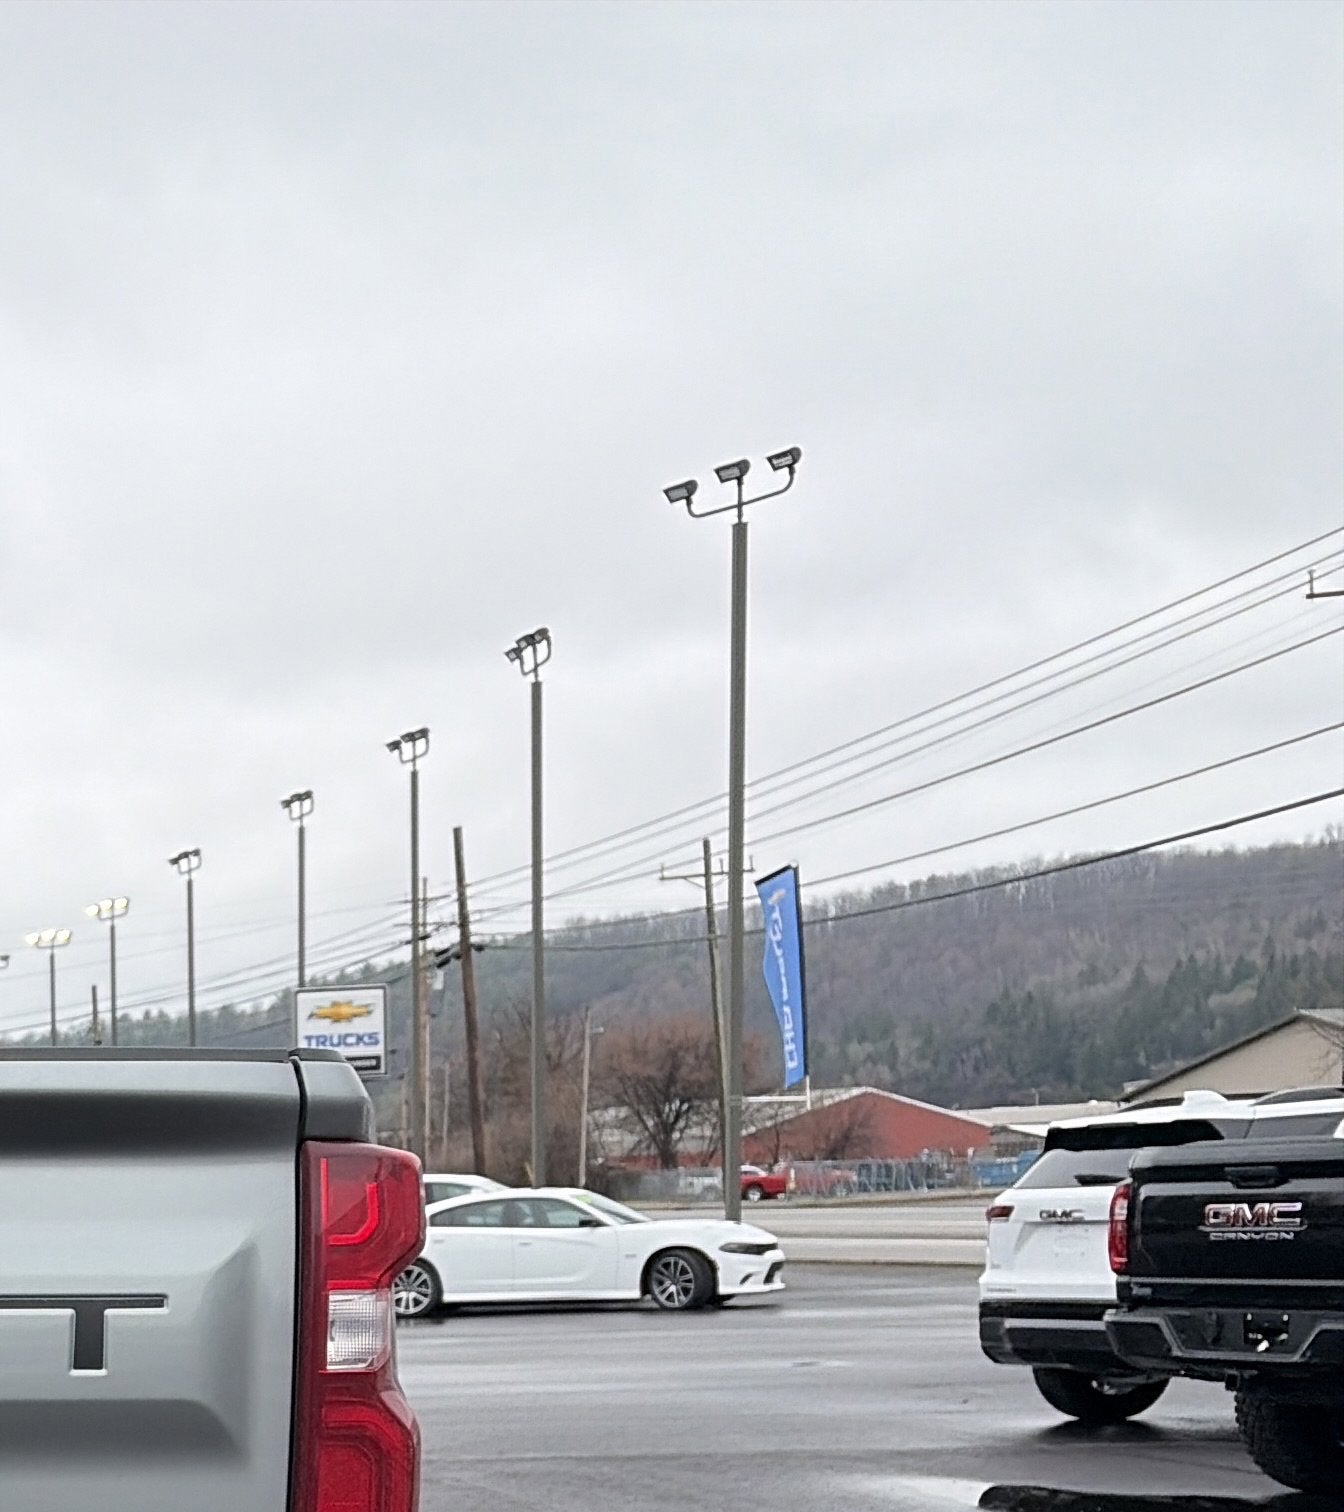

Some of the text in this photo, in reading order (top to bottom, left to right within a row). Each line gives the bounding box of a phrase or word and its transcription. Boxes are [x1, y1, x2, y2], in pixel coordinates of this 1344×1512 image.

[303, 1031, 380, 1047] TRUCKS
[1039, 1209, 1085, 1221] GMC
[1205, 1202, 1302, 1226] GMC
[1210, 1232, 1294, 1241] CANYON
